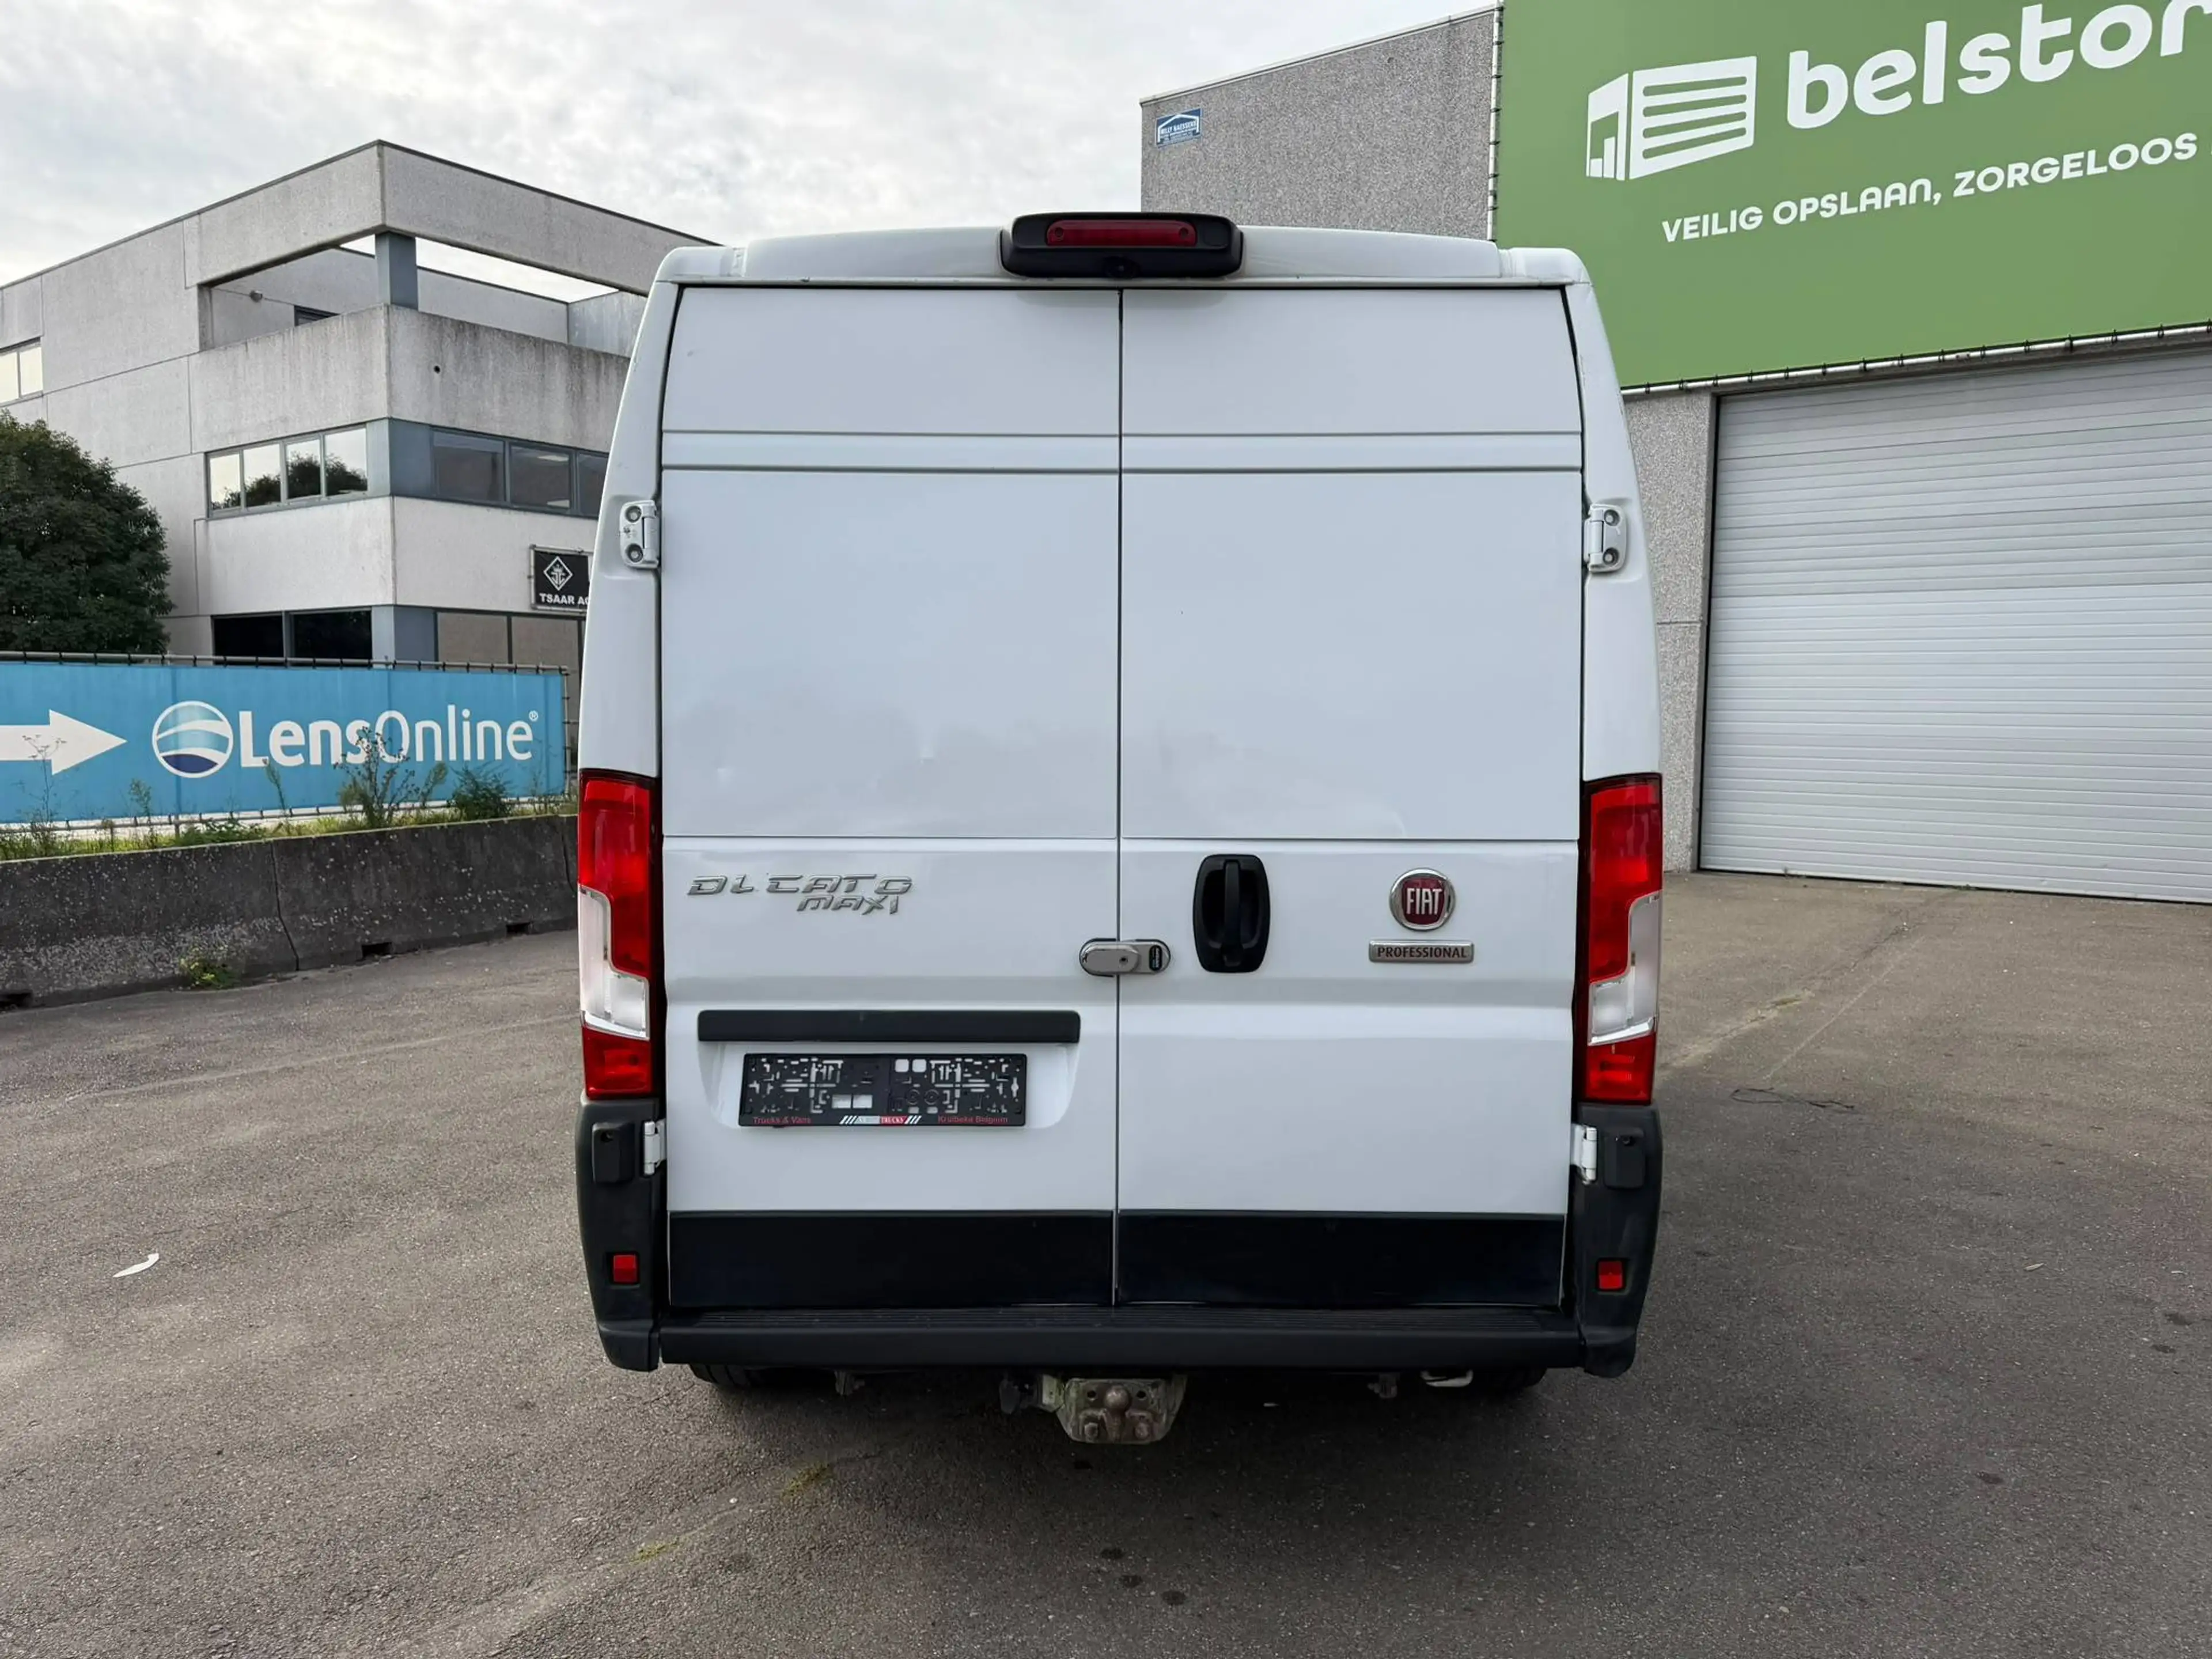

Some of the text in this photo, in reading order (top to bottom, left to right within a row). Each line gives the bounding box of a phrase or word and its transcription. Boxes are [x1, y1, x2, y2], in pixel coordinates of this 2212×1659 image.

[1787, 0, 2212, 128] belstor
[1662, 206, 1763, 243] VEILIG
[1772, 178, 1941, 225] OPSLAAN,
[1953, 132, 2198, 196] ZORGELOOS
[539, 593, 575, 605] TSAAR
[797, 895, 899, 915] MAXI
[1406, 888, 1442, 915] FIAT
[1377, 947, 1468, 958] PROFESSIONAL
